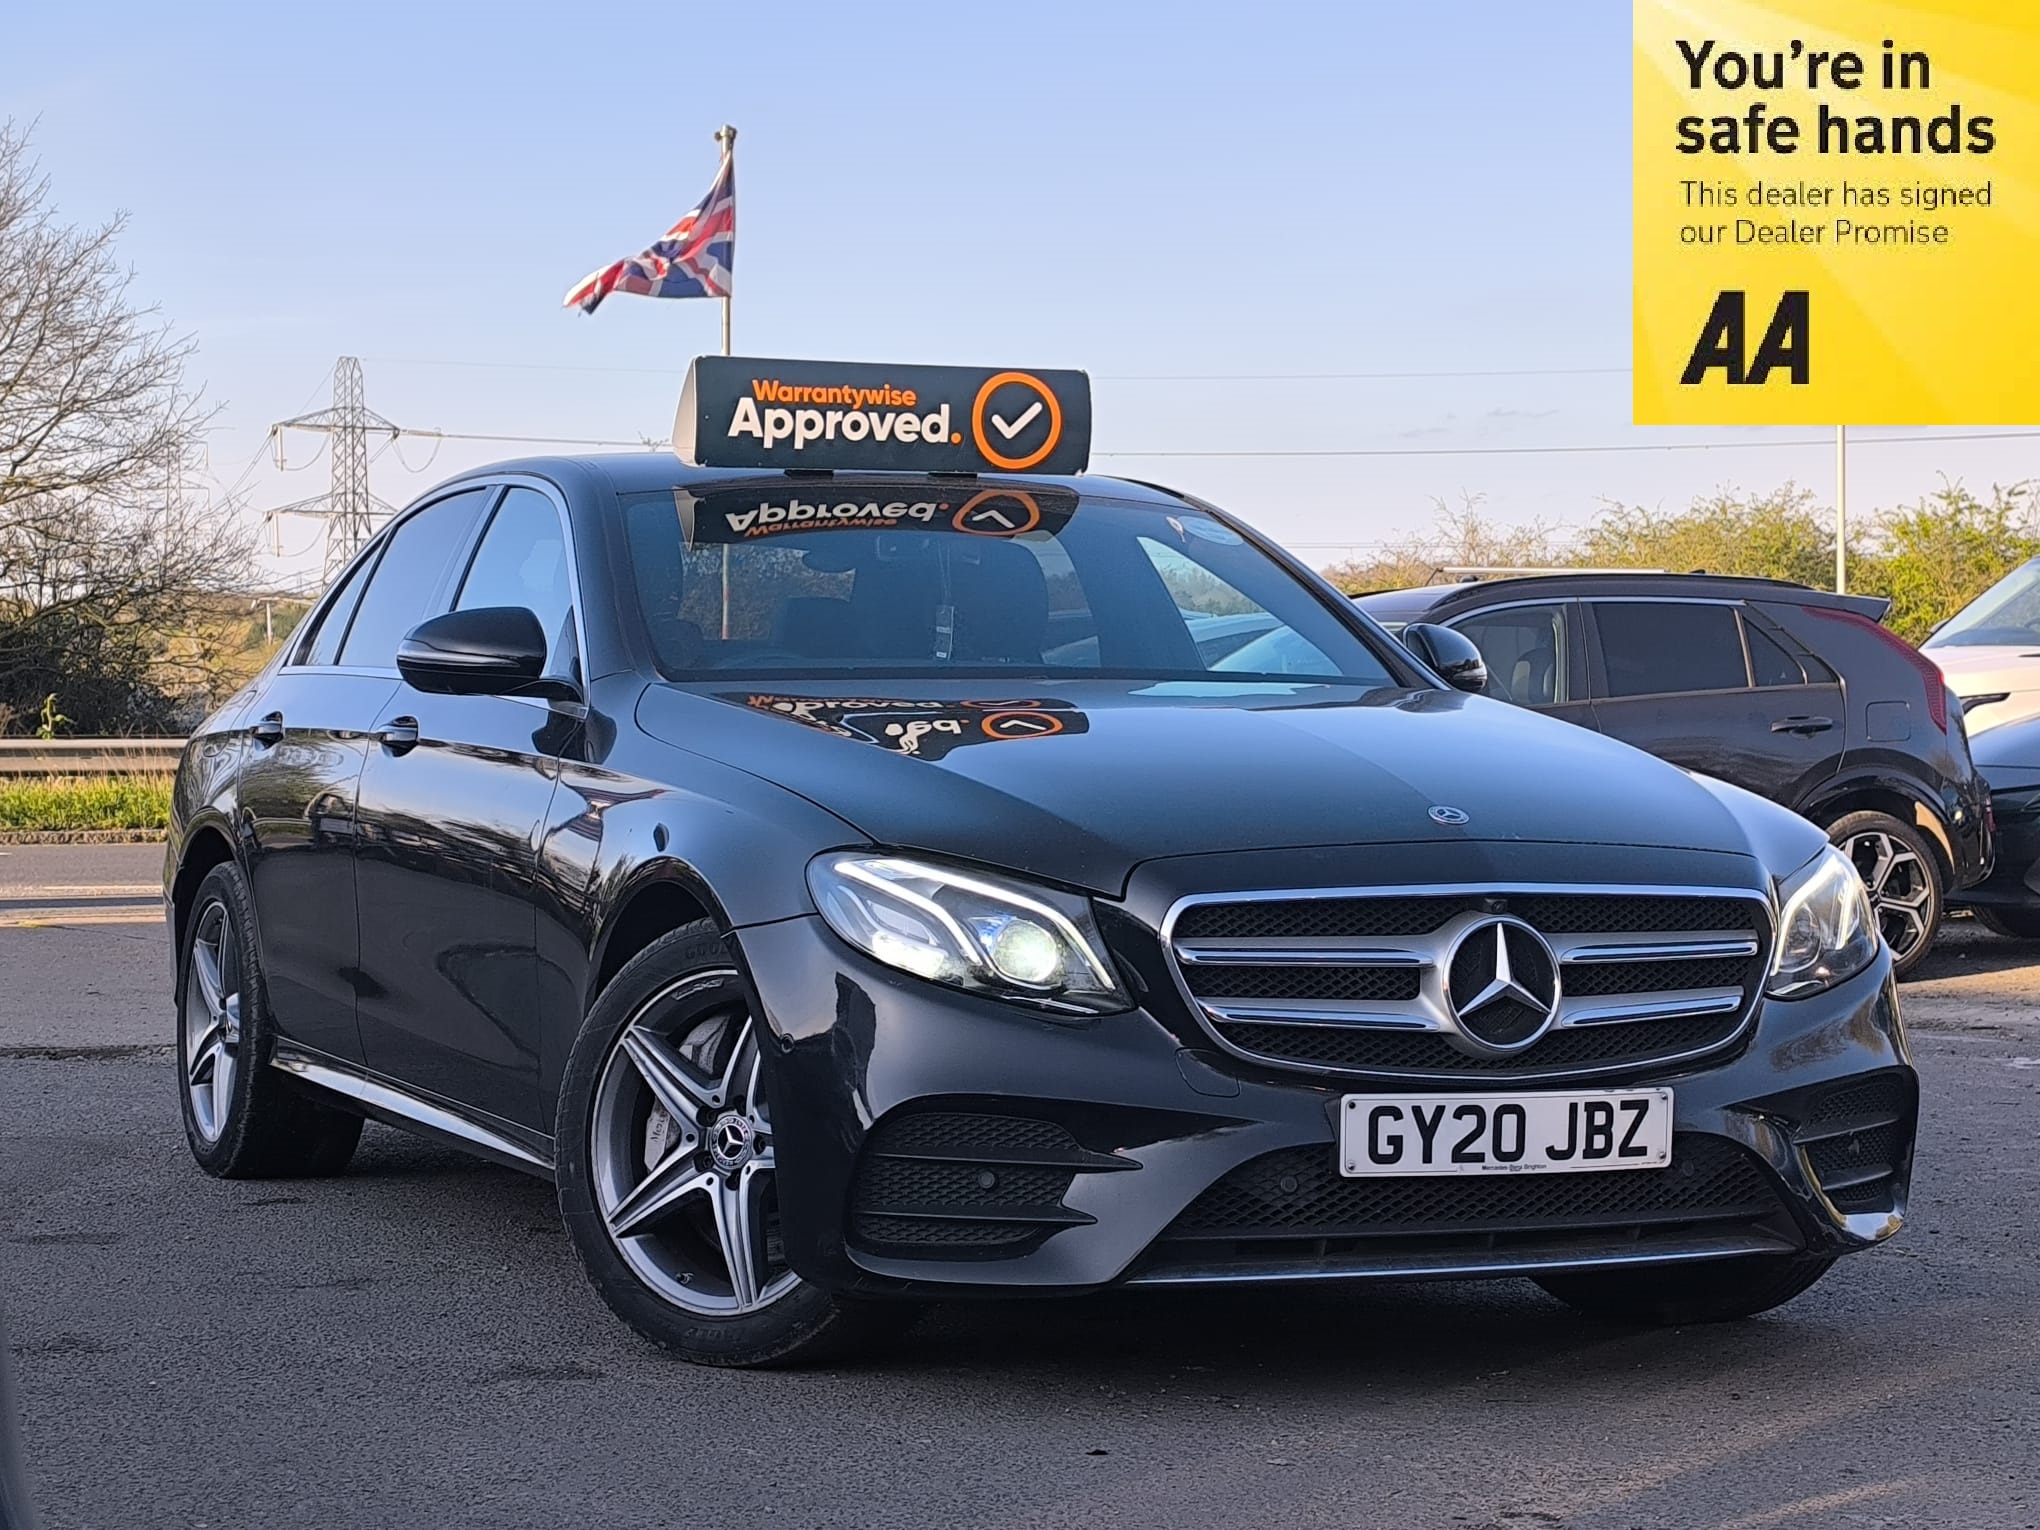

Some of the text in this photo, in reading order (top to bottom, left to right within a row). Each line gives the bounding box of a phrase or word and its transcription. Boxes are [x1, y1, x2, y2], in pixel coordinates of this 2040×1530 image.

[751, 379, 917, 410] Warrantywise
[727, 396, 962, 451] Approved.
[1367, 1098, 1651, 1166] GY20 JBZ
